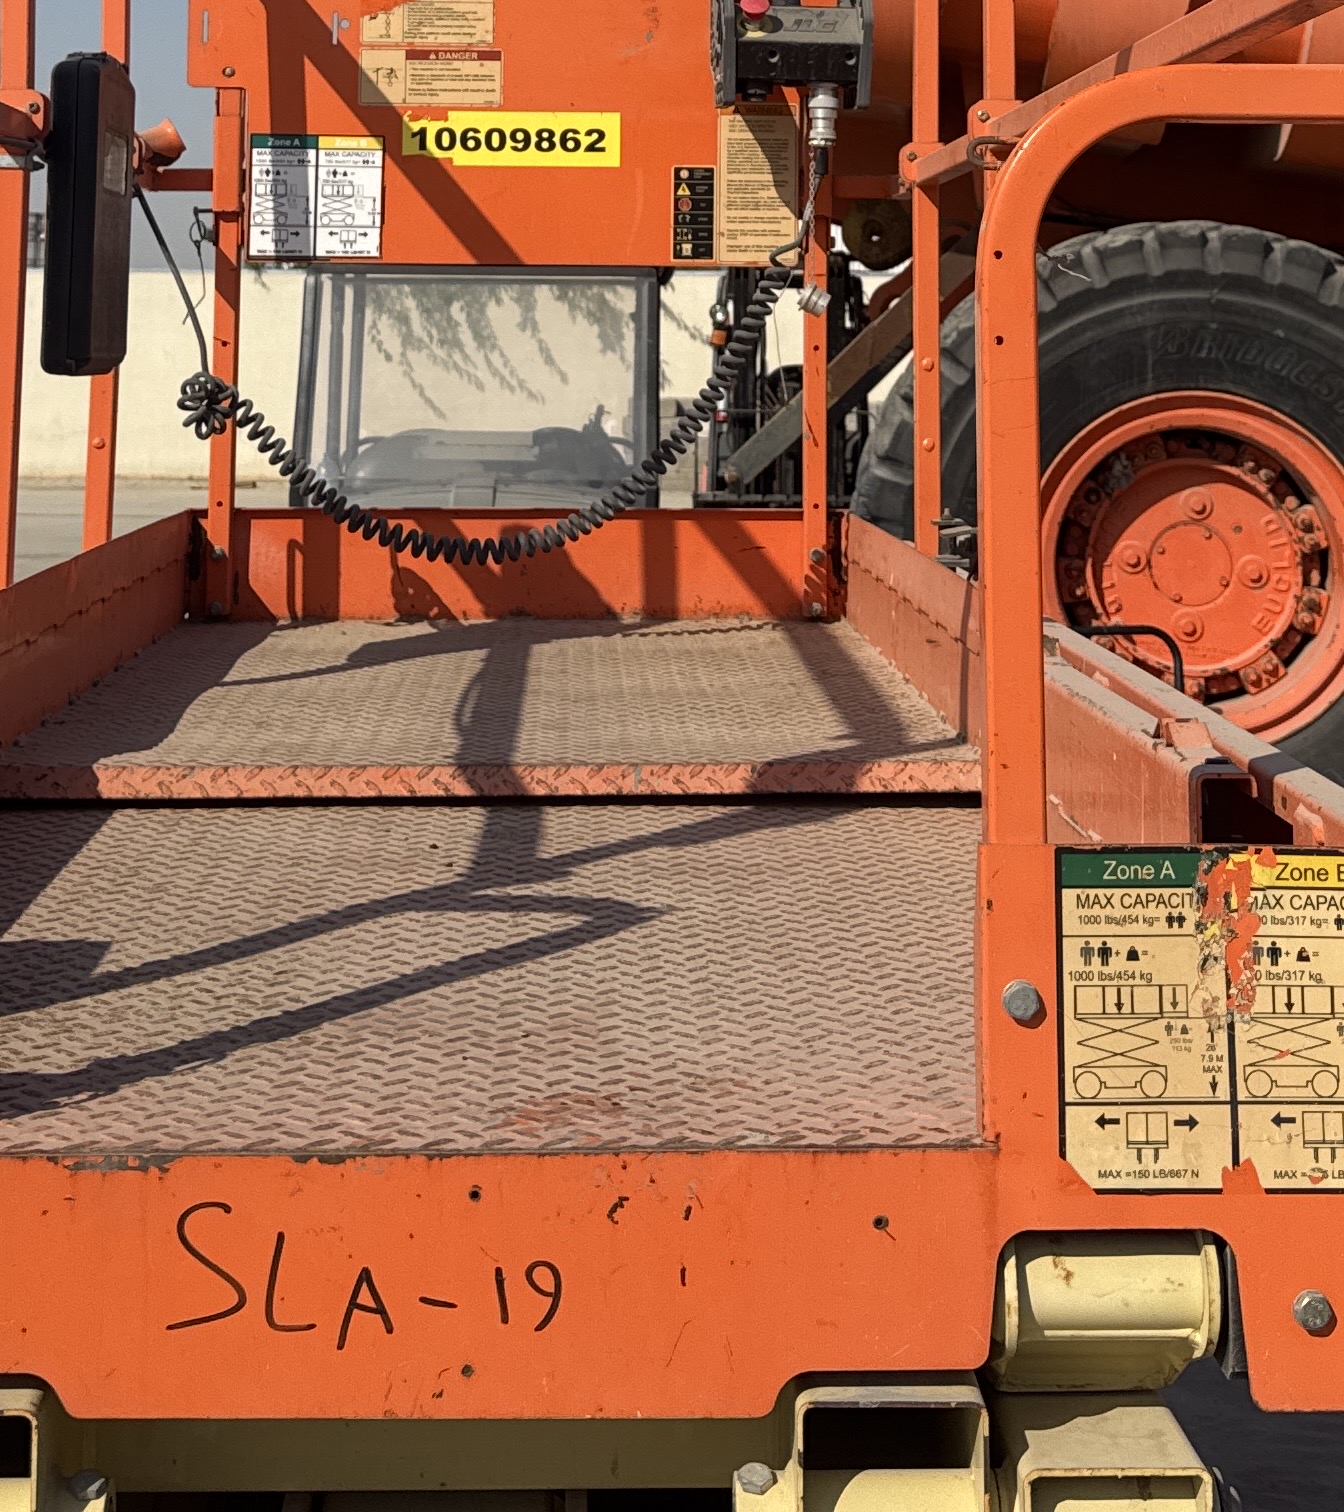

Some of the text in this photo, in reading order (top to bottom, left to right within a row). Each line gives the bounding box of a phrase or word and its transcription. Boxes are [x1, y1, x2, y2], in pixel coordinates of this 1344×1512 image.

[438, 52, 479, 60] DANGER
[293, 138, 300, 146] A
[411, 127, 606, 153] 10609862
[1103, 860, 1176, 880] Zone A
[1275, 862, 1329, 882] Zone
[1076, 892, 1194, 909] MAX CAPACIT
[1078, 915, 1102, 925] 1000
[1068, 970, 1153, 983] 1000 lbs/454 kg
[1266, 970, 1305, 982] lbs/317
[1309, 971, 1322, 984] kg
[1216, 1054, 1224, 1062] M
[1202, 1065, 1223, 1074] MAX
[1098, 1169, 1123, 1179] MAX
[1191, 1169, 1200, 1179] N
[1273, 1170, 1298, 1180] MAX
[165, 1201, 563, 1351] SLA-19
